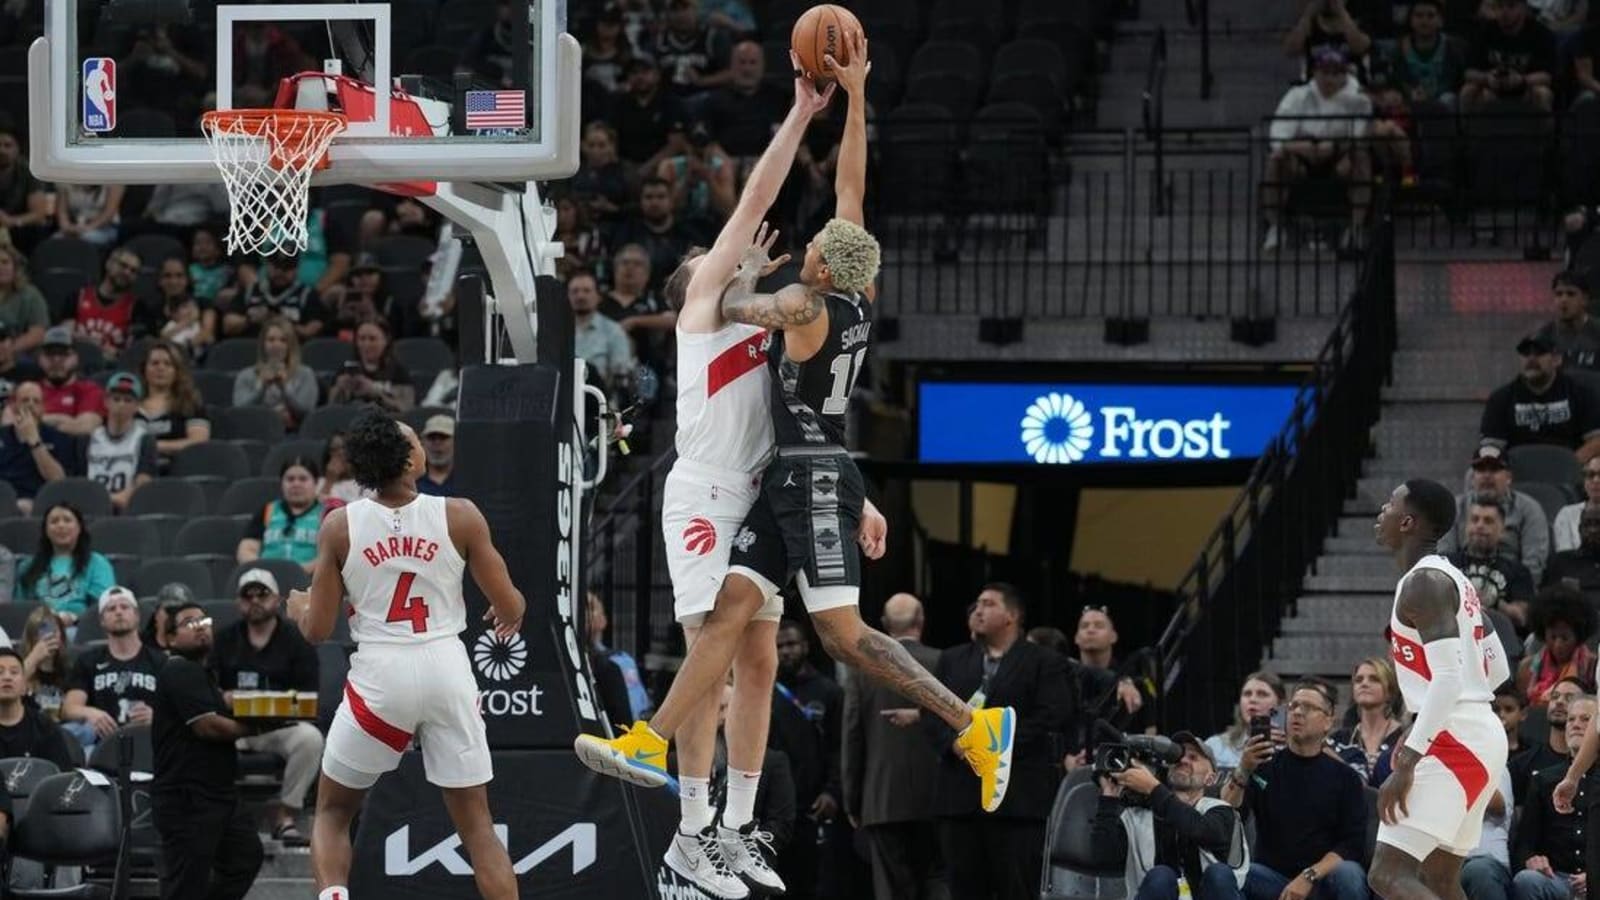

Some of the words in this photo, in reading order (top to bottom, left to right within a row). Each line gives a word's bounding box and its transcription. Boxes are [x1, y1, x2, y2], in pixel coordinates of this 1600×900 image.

[1099, 406, 1231, 459] Frost
[363, 536, 439, 568] BARNES
[386, 571, 430, 634] 4
[479, 684, 544, 716] rost
